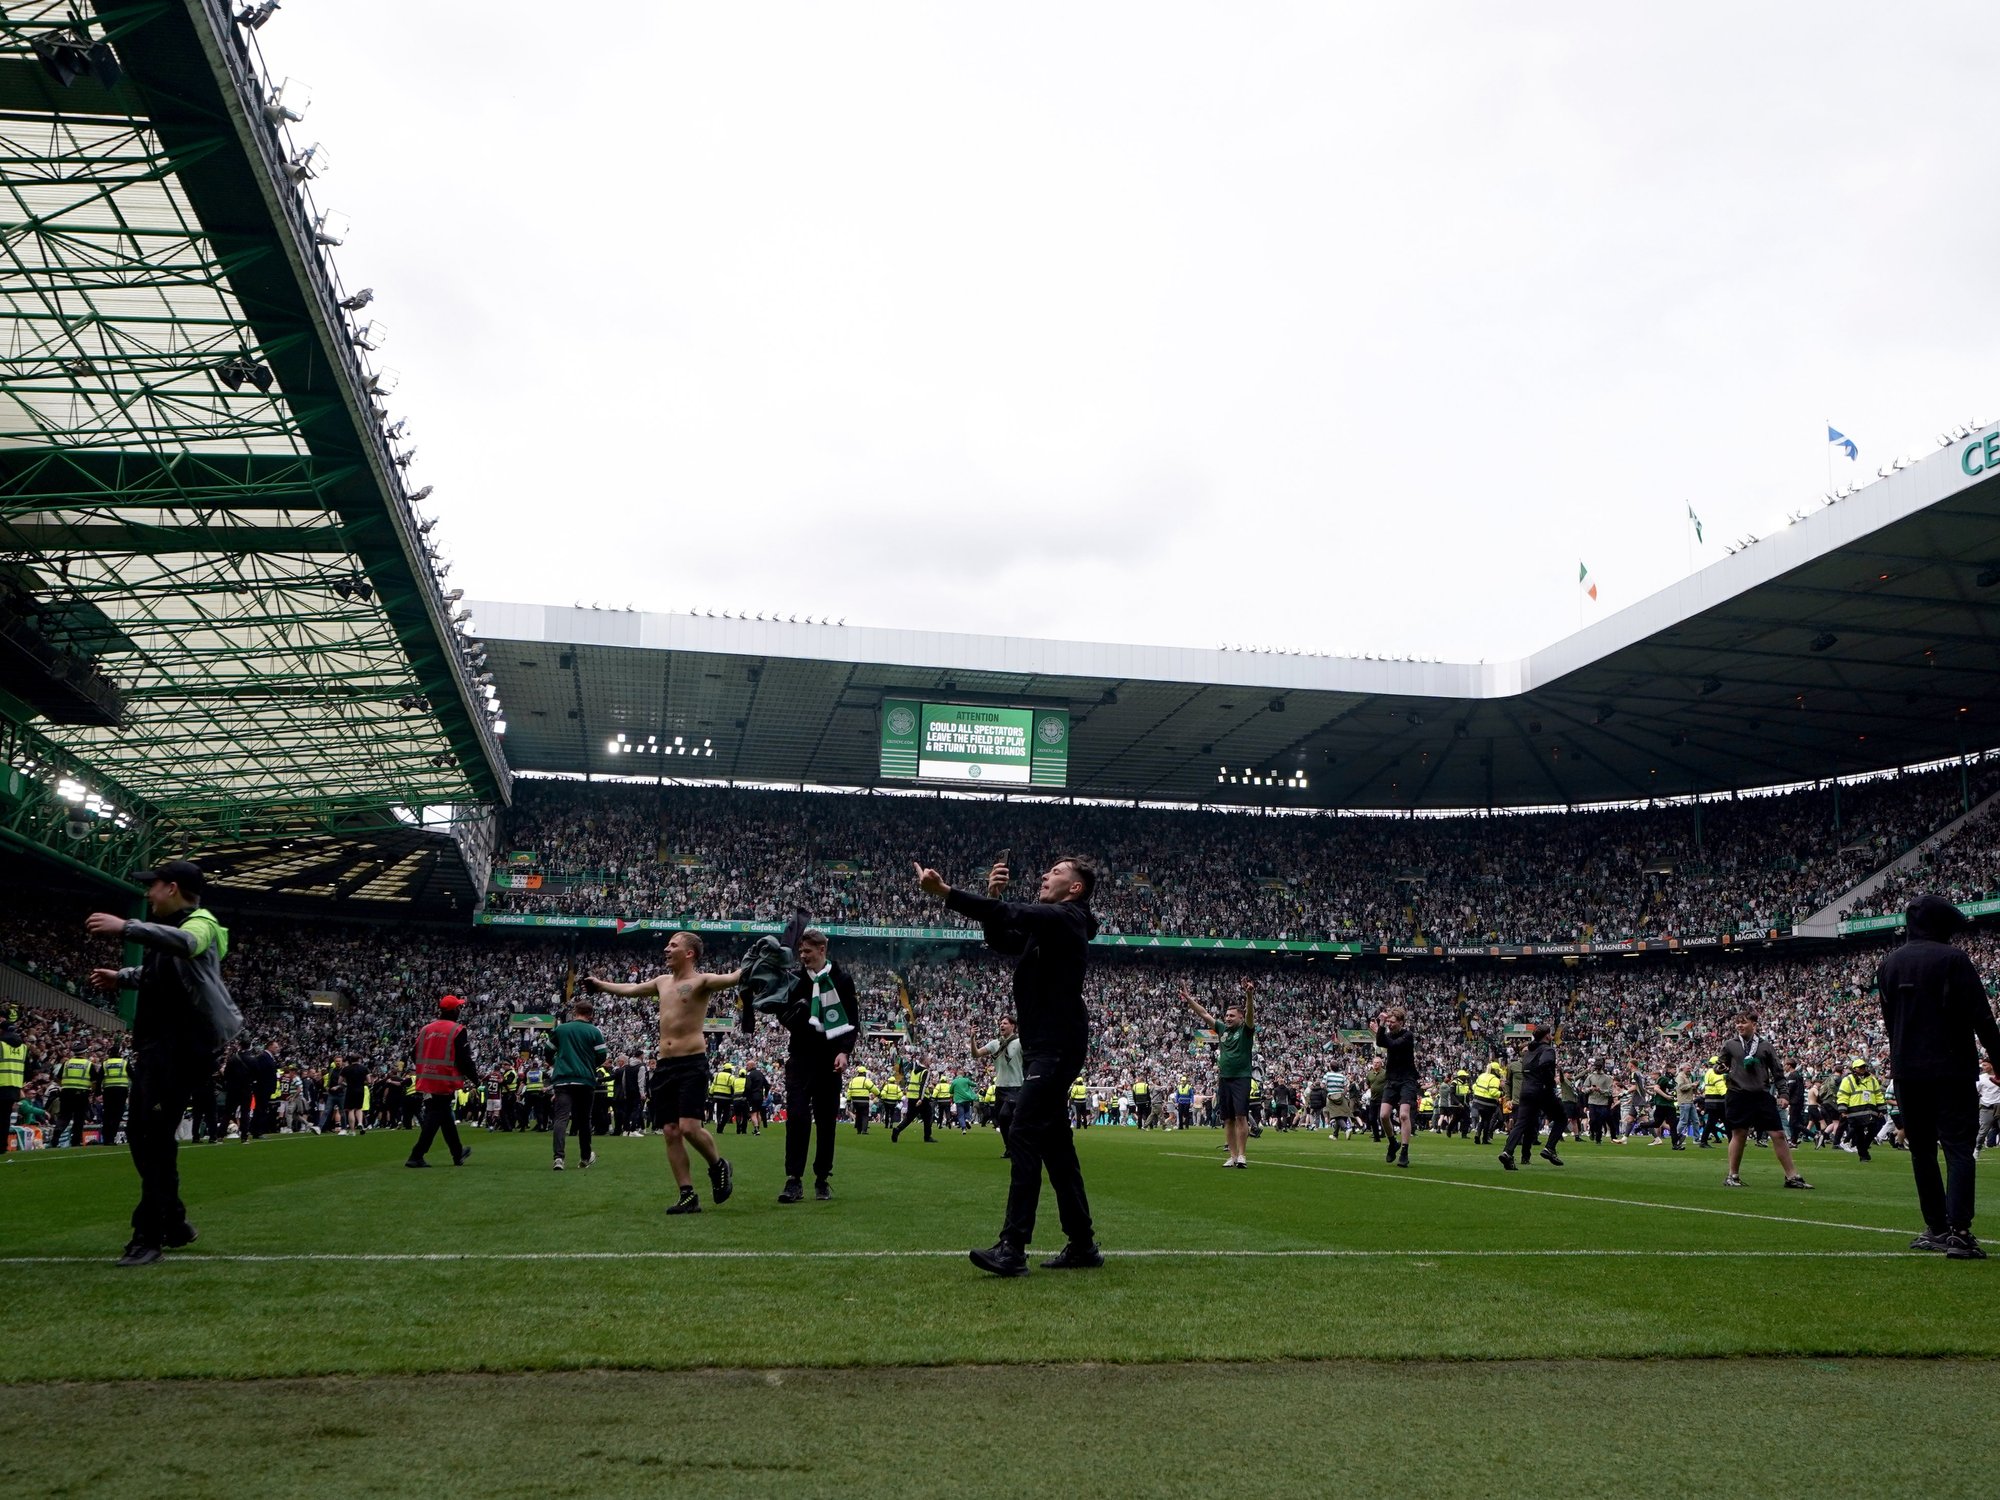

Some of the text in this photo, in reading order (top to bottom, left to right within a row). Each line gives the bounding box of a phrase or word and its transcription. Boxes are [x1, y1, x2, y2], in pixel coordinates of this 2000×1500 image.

[957, 711, 999, 722] ATTENTION
[930, 722, 1023, 737] COULD ALL SPECTATORS
[927, 732, 1025, 747] LEAVE THE FIELD OF PLAY
[926, 742, 1025, 756] & RETURN TO THE STANDS
[492, 915, 524, 924] dafabet
[546, 917, 577, 926] dafabet
[650, 920, 680, 929] dafabet
[701, 921, 731, 931] dafabet
[751, 923, 781, 932] dafabet
[1734, 931, 1766, 941] MAGNE
[1683, 936, 1717, 946] MAGNERS
[1538, 945, 1574, 953] MAGNERS
[1595, 943, 1631, 951] MAGNERS
[488, 1082, 498, 1091] 29
